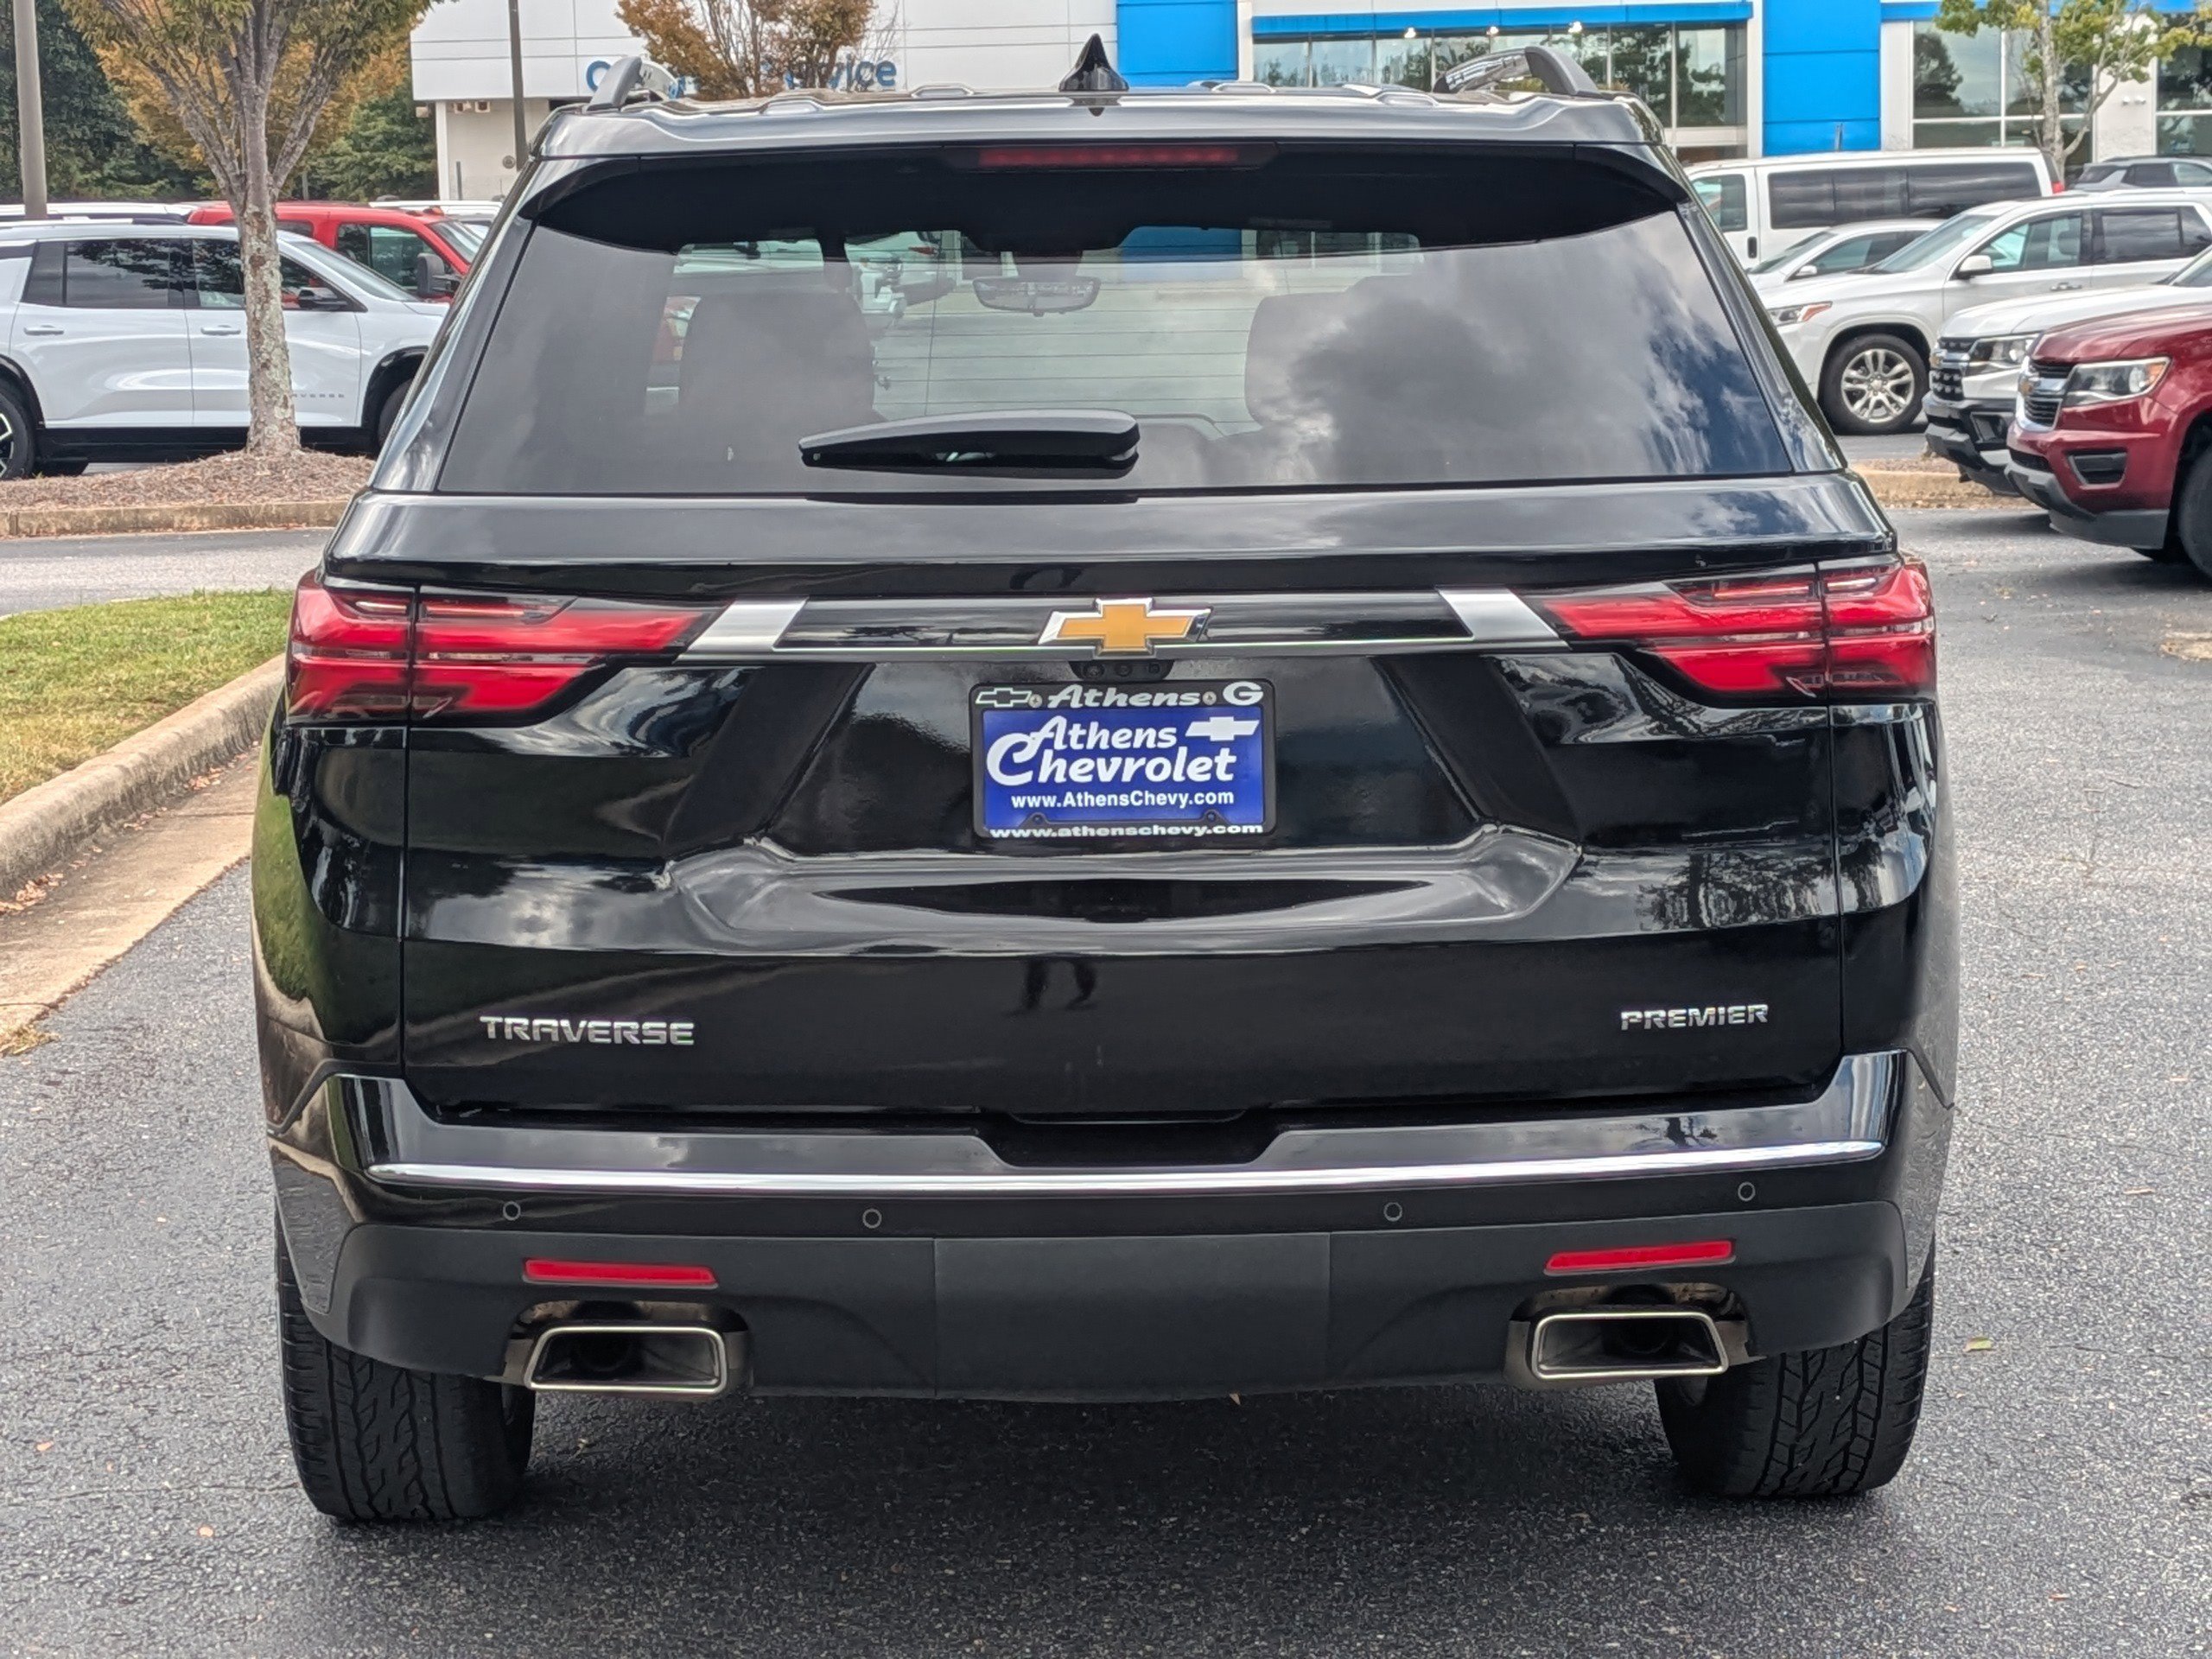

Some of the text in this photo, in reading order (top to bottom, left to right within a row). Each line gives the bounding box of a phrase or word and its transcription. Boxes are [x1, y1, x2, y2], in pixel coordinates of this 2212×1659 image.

[1047, 681, 1264, 709] Athens G
[1027, 715, 1177, 751] Athens
[986, 732, 1237, 786] Chevrolet
[1010, 790, 1235, 809] www.AthensChevy.com
[989, 823, 1264, 839] www.athenschevy.com
[480, 1015, 695, 1046] TRAVERSE
[1620, 1003, 1769, 1031] PREMIER
